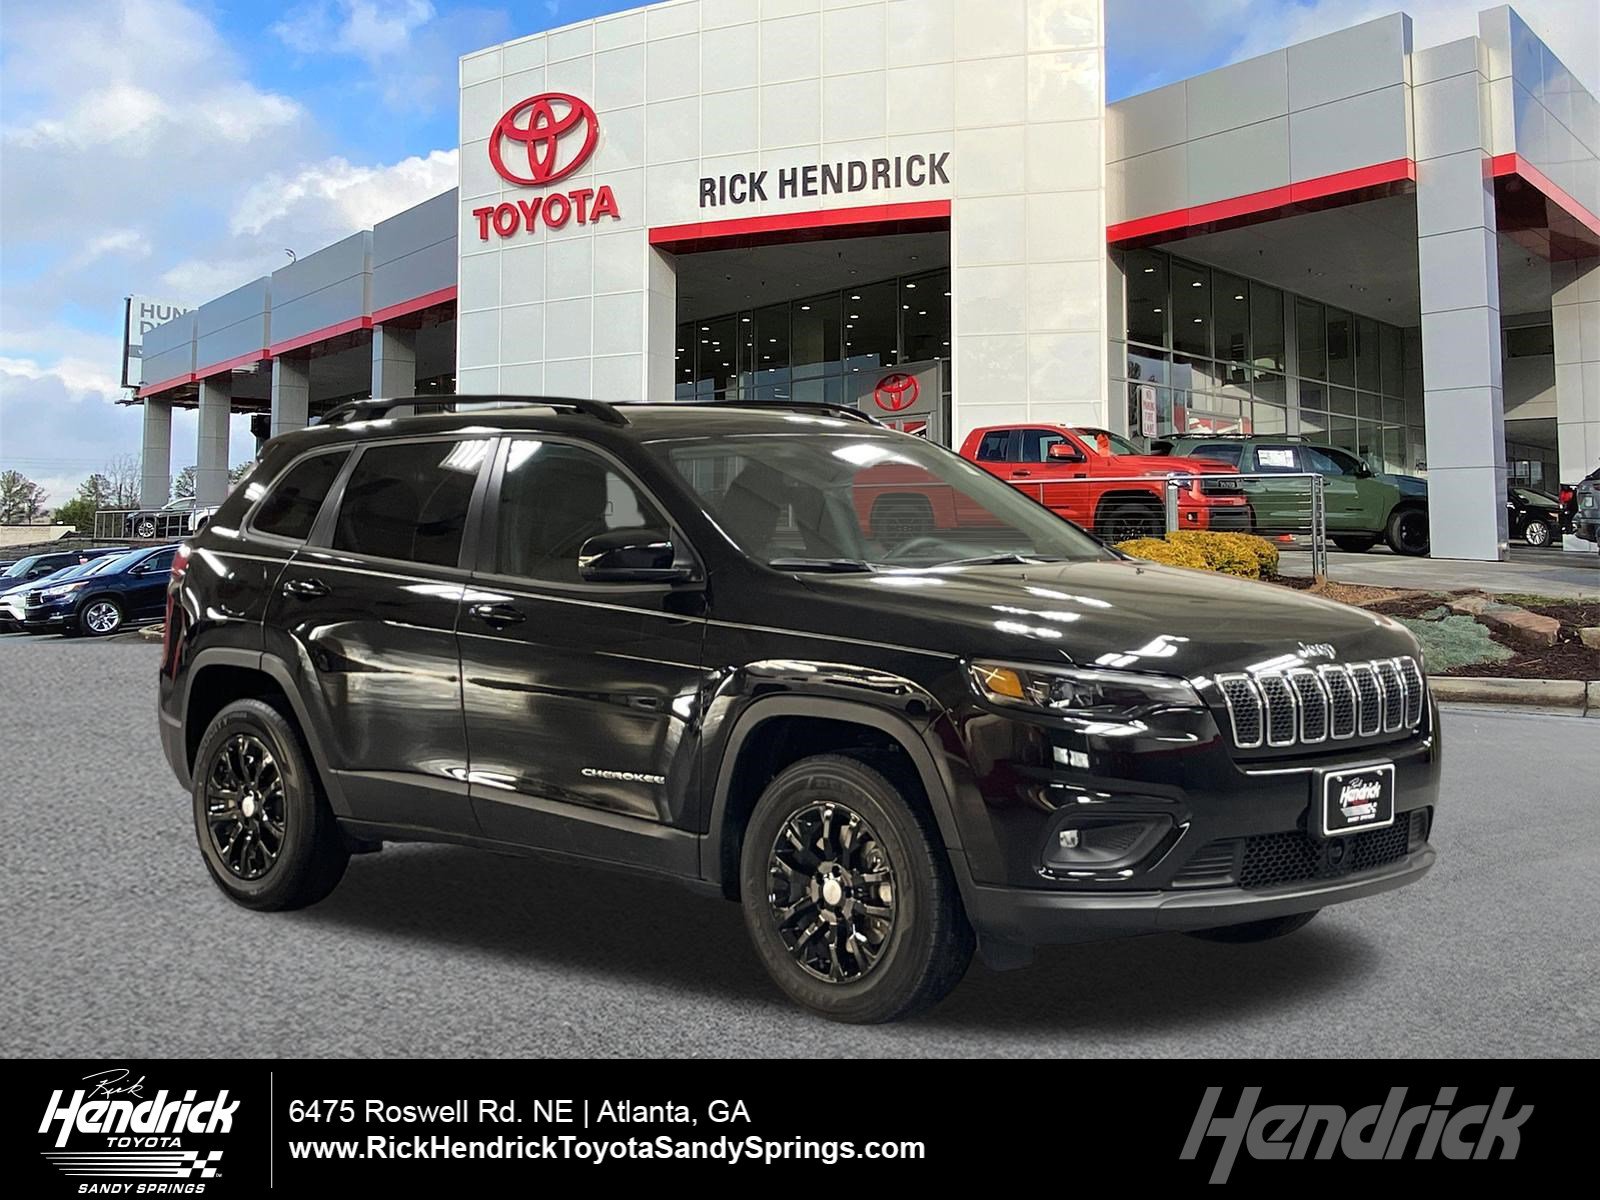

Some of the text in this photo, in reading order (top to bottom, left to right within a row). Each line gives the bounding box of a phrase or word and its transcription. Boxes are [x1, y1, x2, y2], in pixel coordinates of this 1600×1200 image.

[699, 152, 951, 207] RICK HENDRICK
[473, 185, 621, 241] TOYOTA
[1297, 641, 1336, 660] Jeep
[581, 768, 665, 784] CHEROKEE
